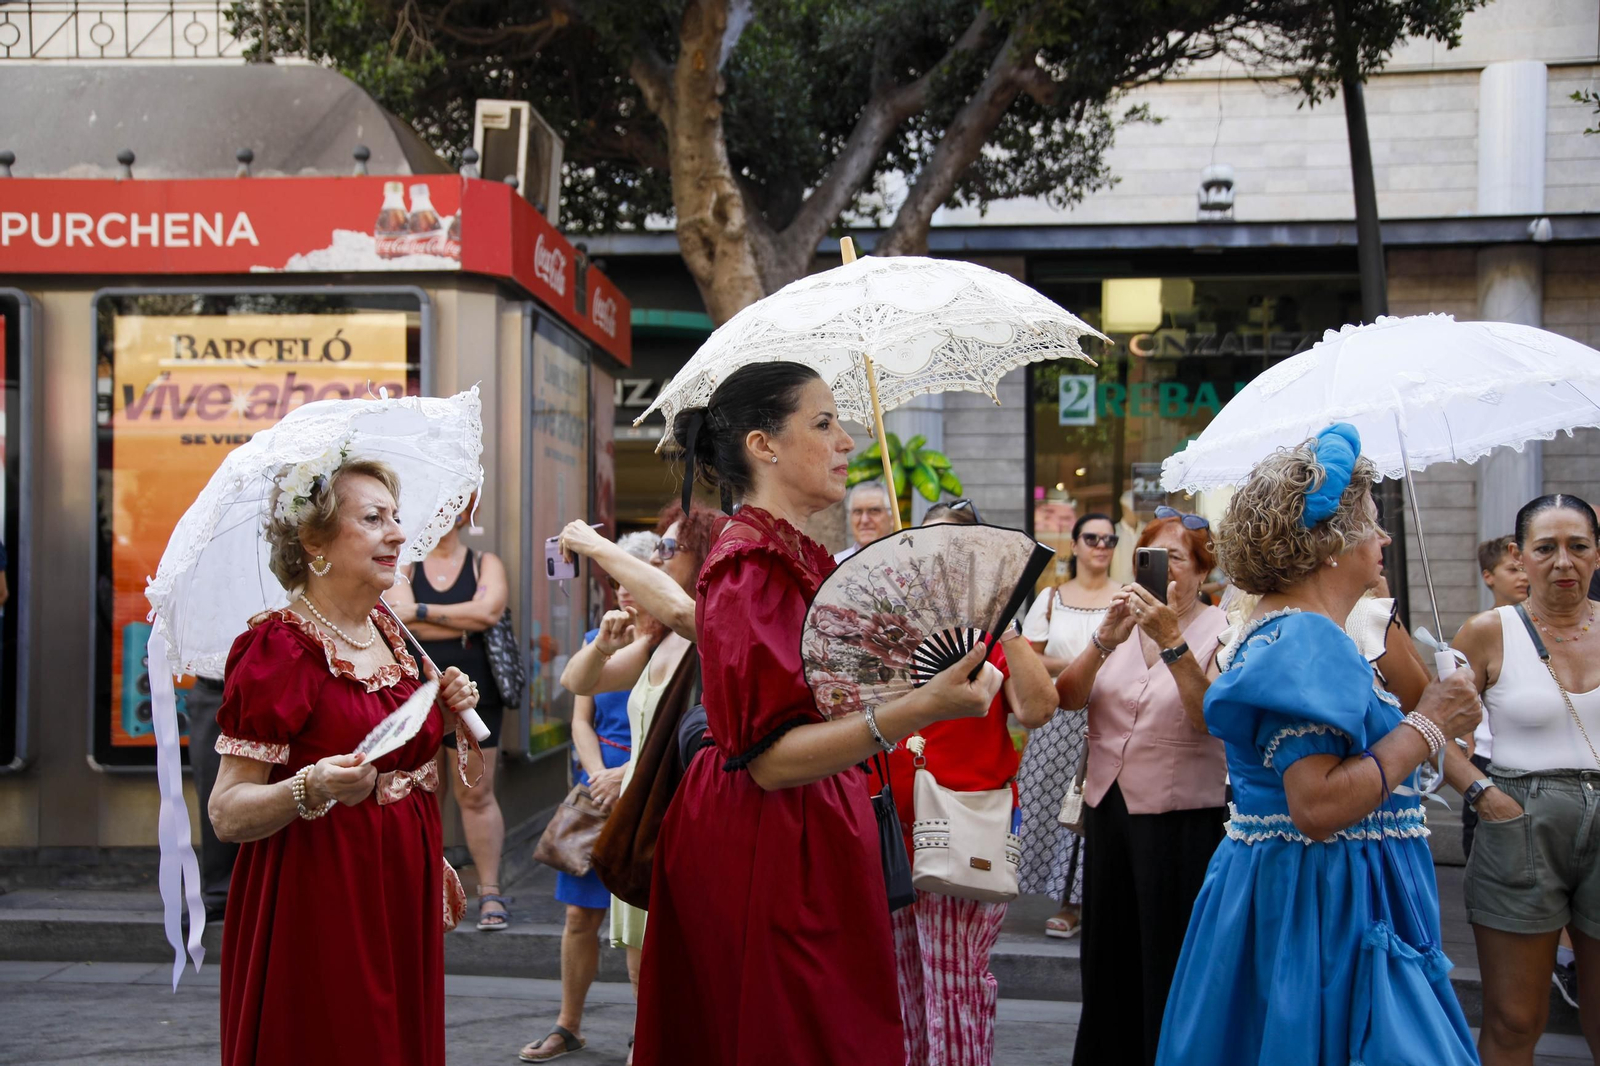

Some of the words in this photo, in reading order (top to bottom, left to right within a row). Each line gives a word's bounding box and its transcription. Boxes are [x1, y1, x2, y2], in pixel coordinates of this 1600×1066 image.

[1, 211, 260, 248] PURCHENA
[122, 370, 231, 422] vive
[1099, 382, 1246, 418] REBA
[180, 434, 206, 445] SE
